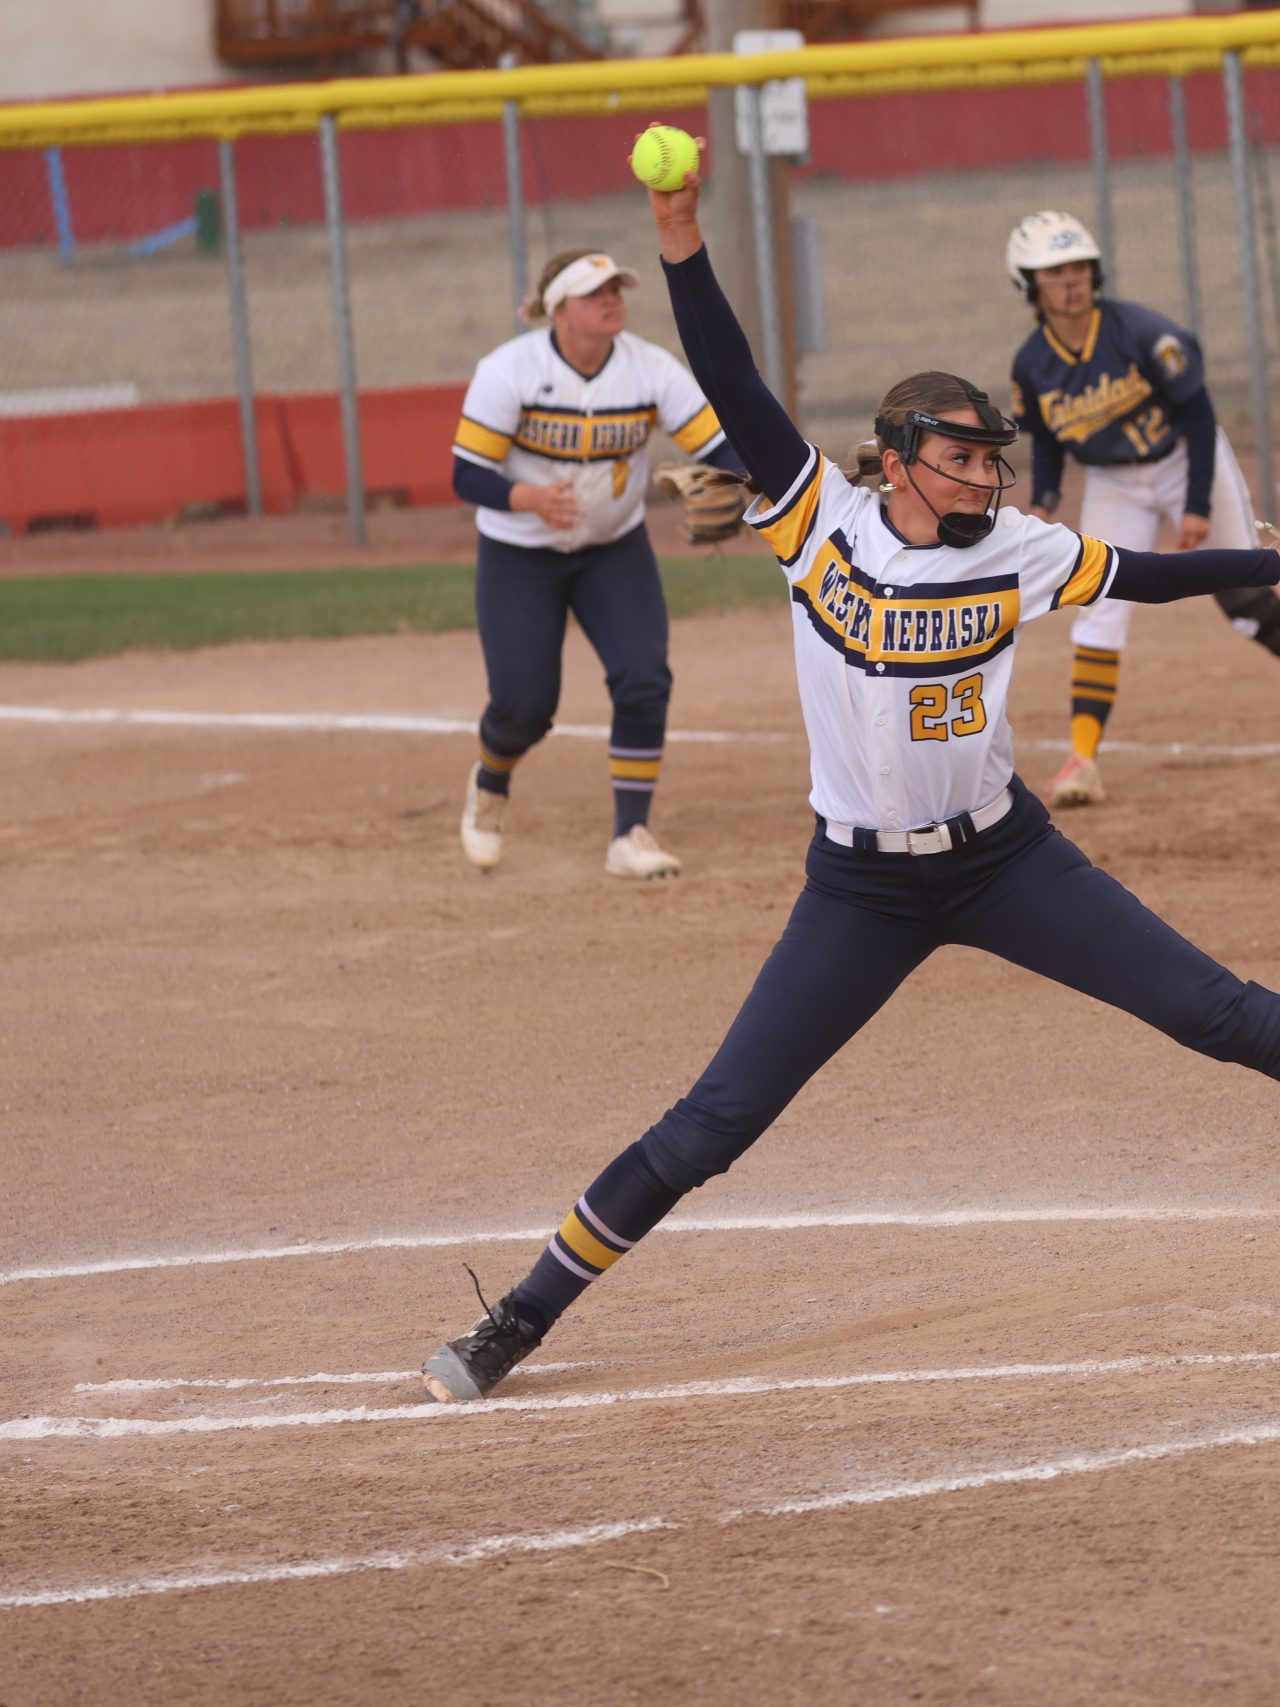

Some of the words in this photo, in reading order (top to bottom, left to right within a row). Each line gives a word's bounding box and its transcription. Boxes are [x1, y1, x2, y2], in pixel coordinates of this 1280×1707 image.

[1123, 405, 1170, 457] 12
[881, 602, 1001, 653] NEBRASKA
[909, 672, 987, 741] 23
